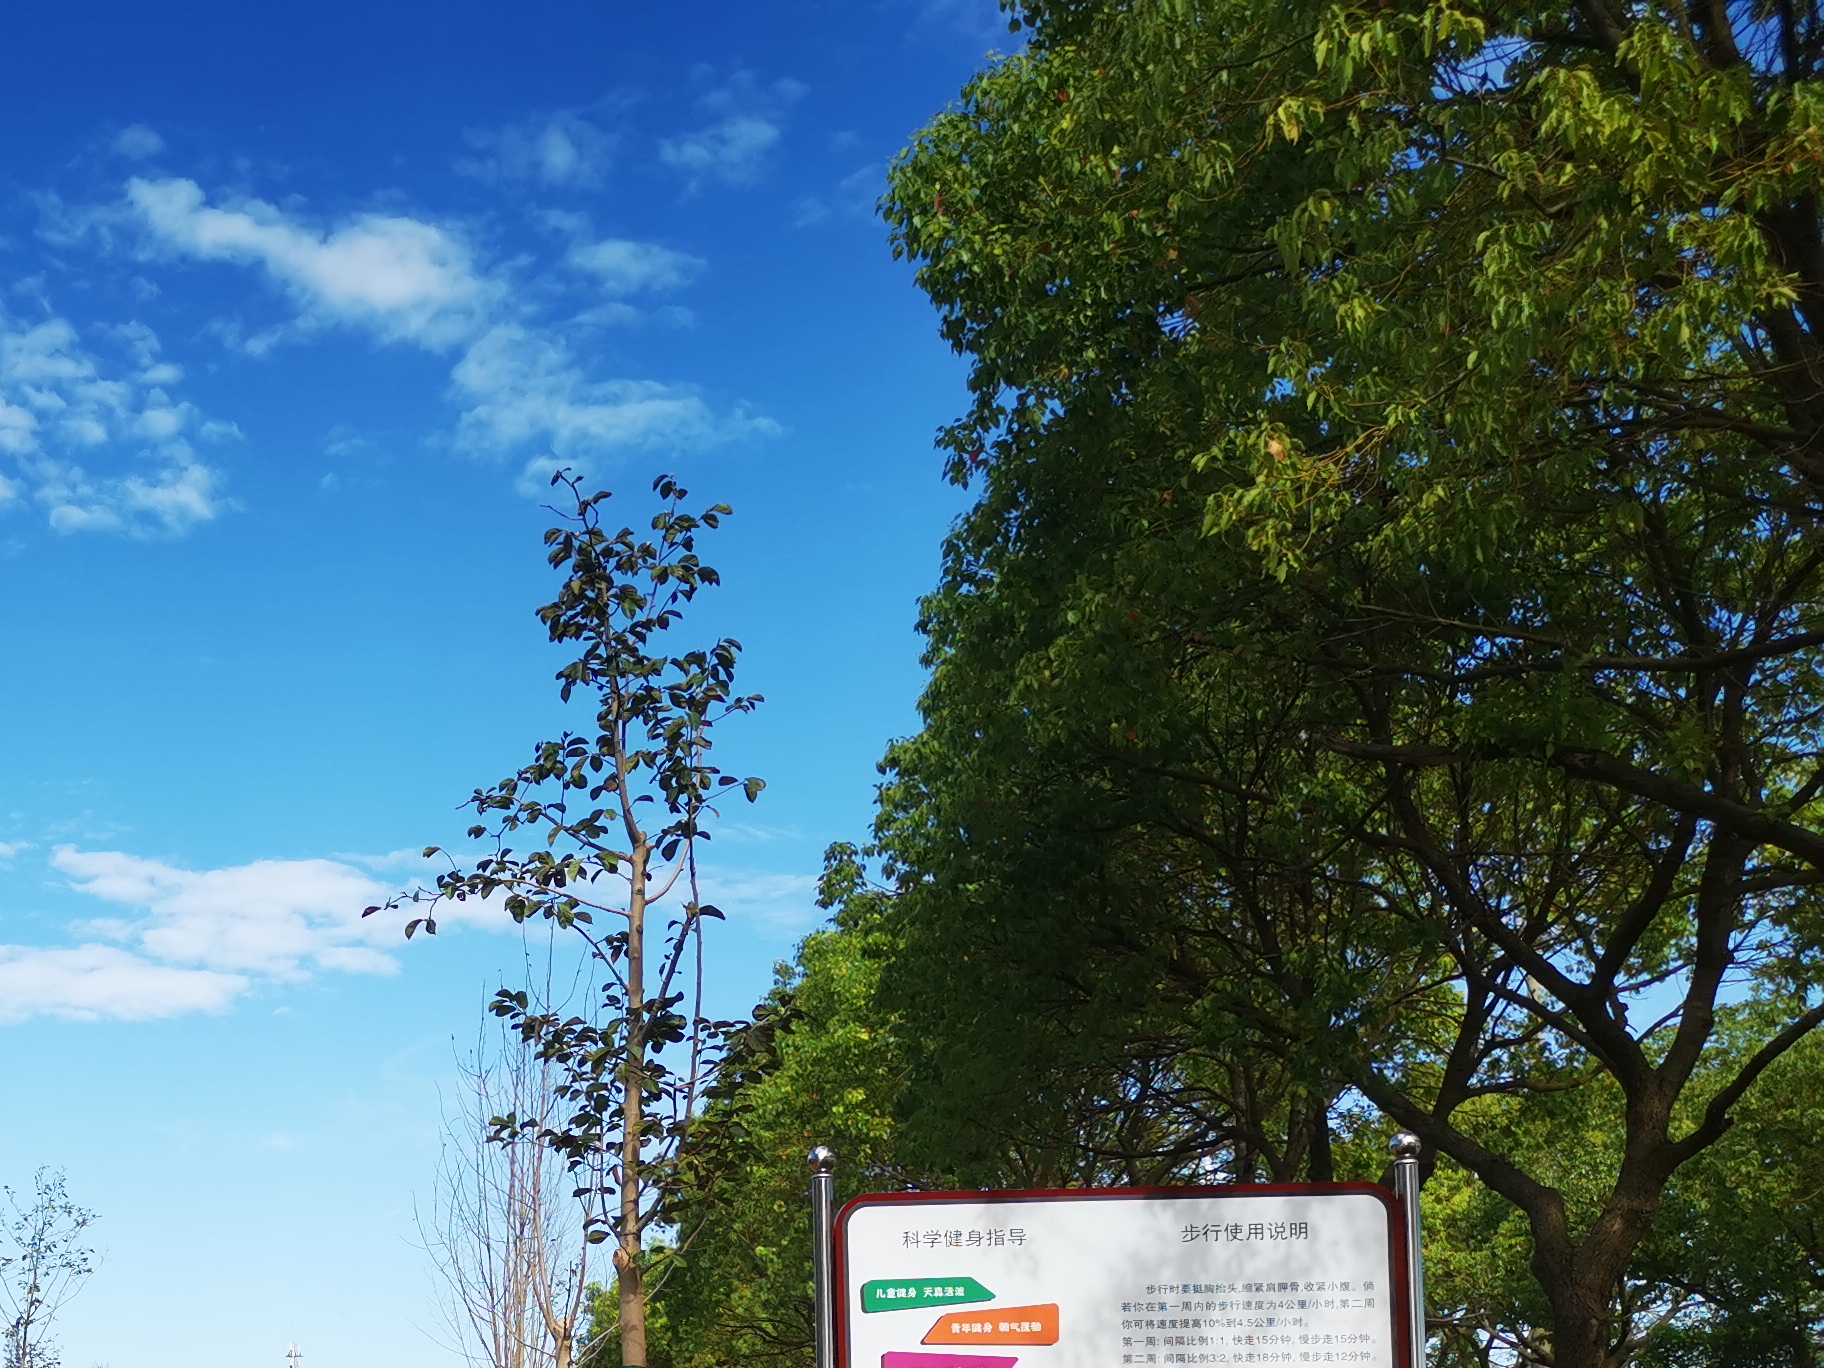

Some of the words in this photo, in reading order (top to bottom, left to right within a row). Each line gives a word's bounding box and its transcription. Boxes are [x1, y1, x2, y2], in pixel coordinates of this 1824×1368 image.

[902, 1227, 1027, 1248] 科学健身指导
[1180, 1221, 1310, 1243] 步行使用说明
[876, 1287, 917, 1299] 儿童健身
[951, 1322, 994, 1334] 青年健身
